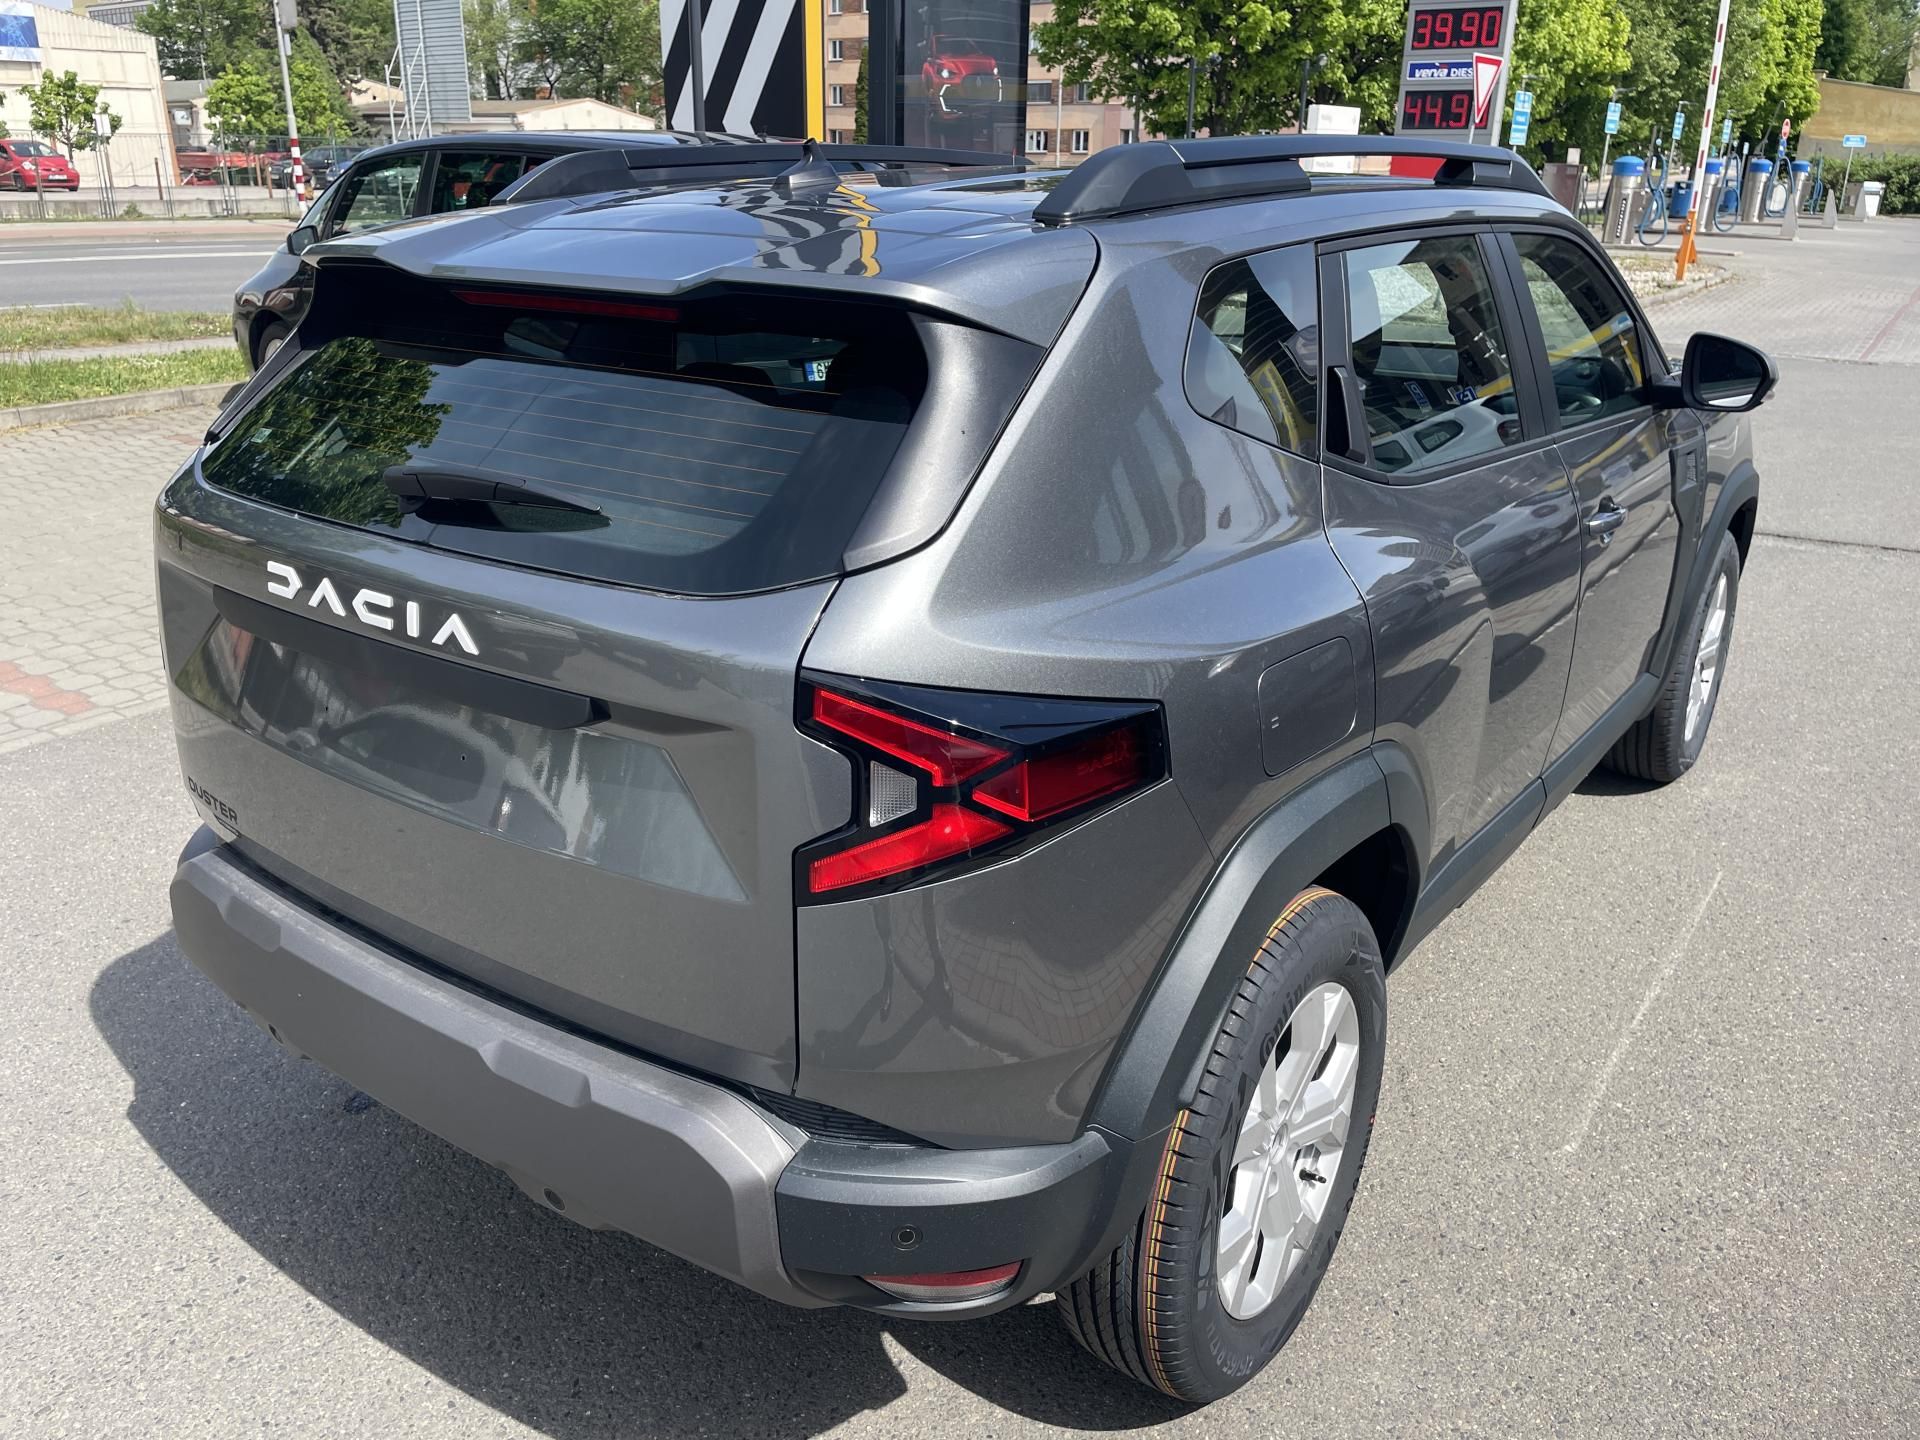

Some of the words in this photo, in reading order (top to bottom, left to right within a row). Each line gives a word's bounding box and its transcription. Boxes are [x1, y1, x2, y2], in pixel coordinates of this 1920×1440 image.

[1412, 10, 1502, 48] 39.90
[1414, 63, 1448, 78] verva
[266, 560, 480, 656] DACIA
[187, 775, 238, 825] DUSTER
